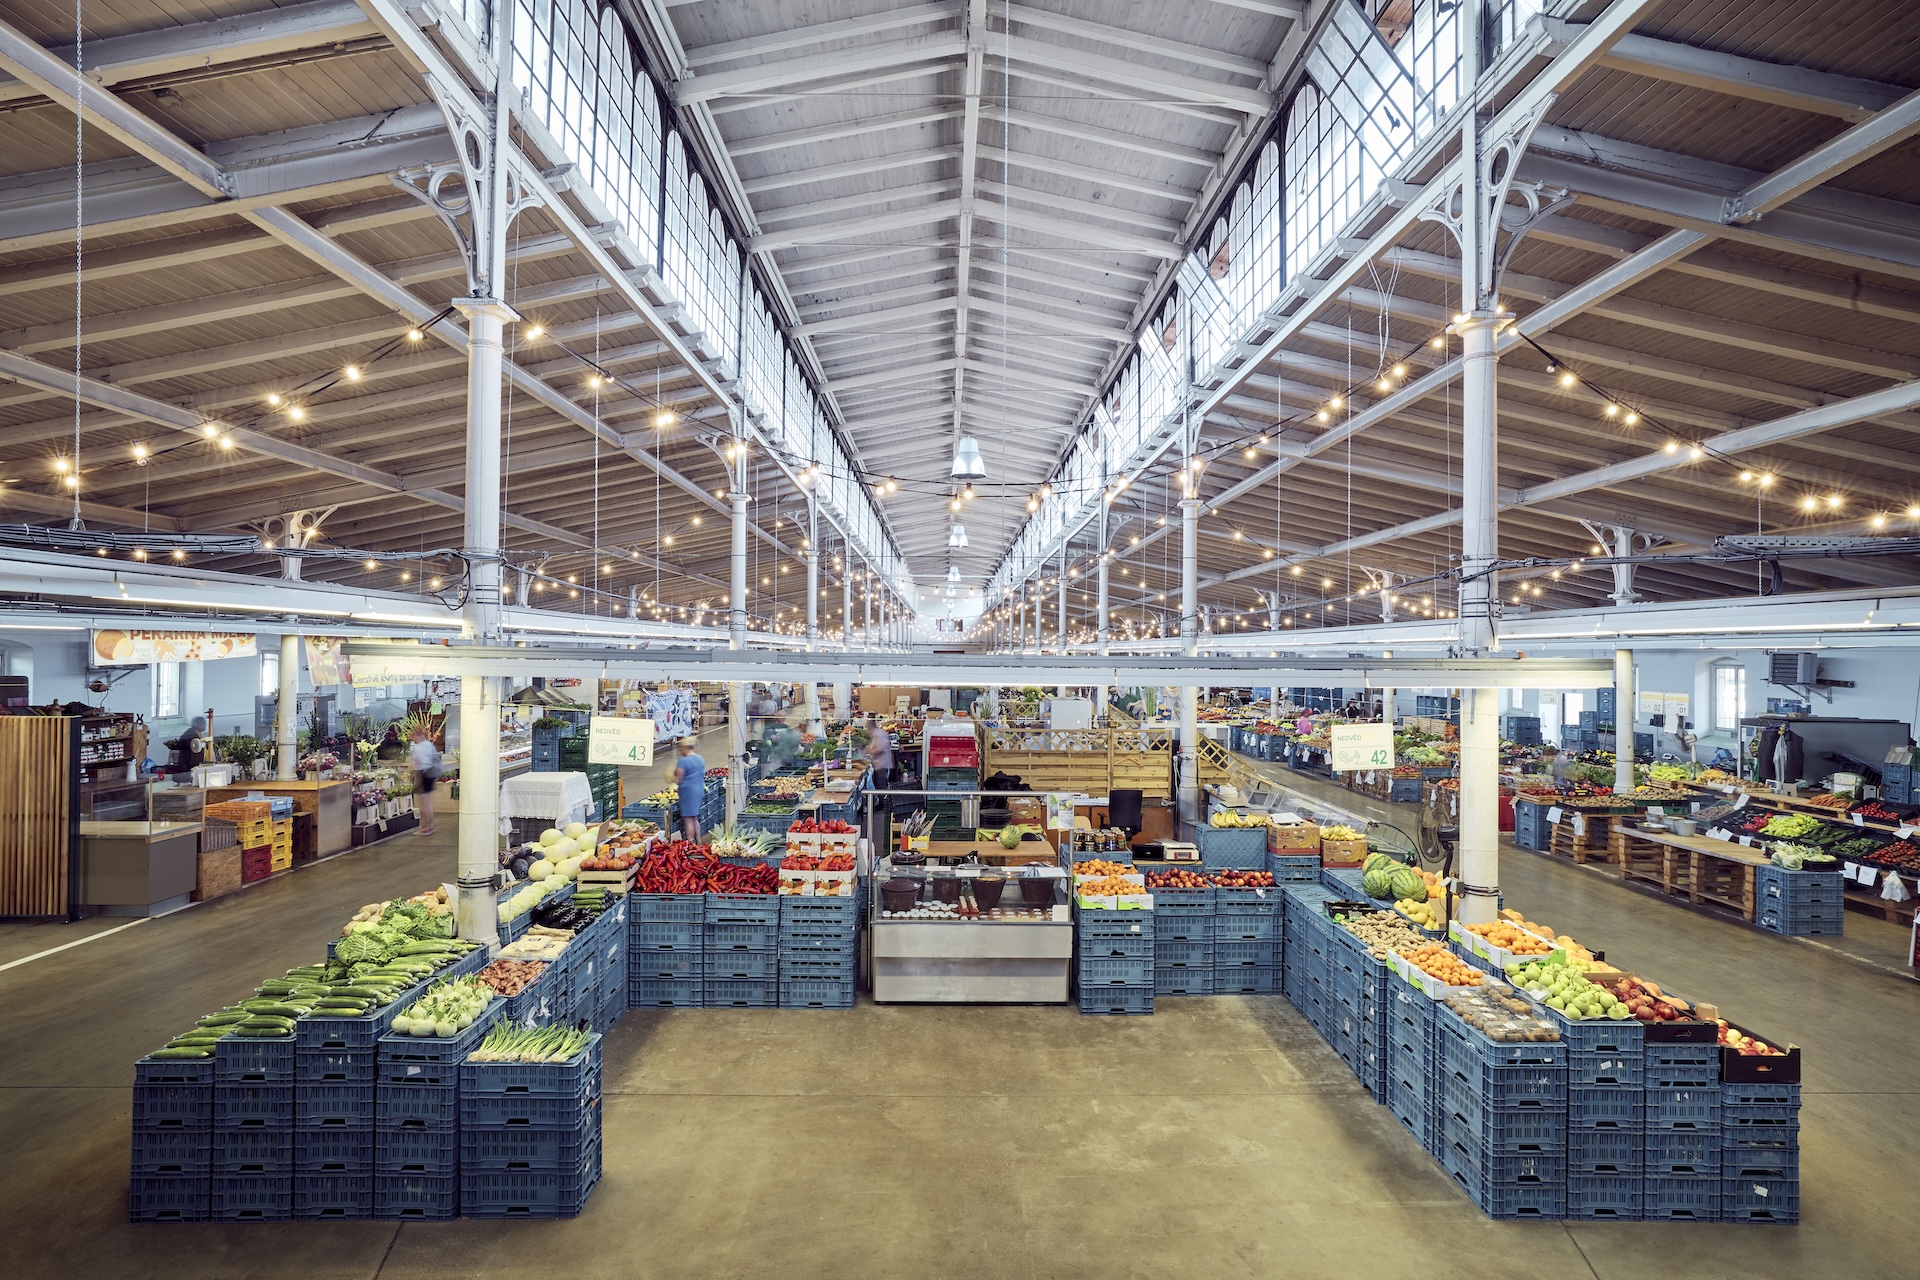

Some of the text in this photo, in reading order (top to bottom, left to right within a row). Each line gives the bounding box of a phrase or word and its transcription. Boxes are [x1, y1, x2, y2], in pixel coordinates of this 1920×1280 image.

[1654, 704, 1661, 712] 02
[628, 745, 646, 761] 43
[1371, 749, 1388, 765] 42
